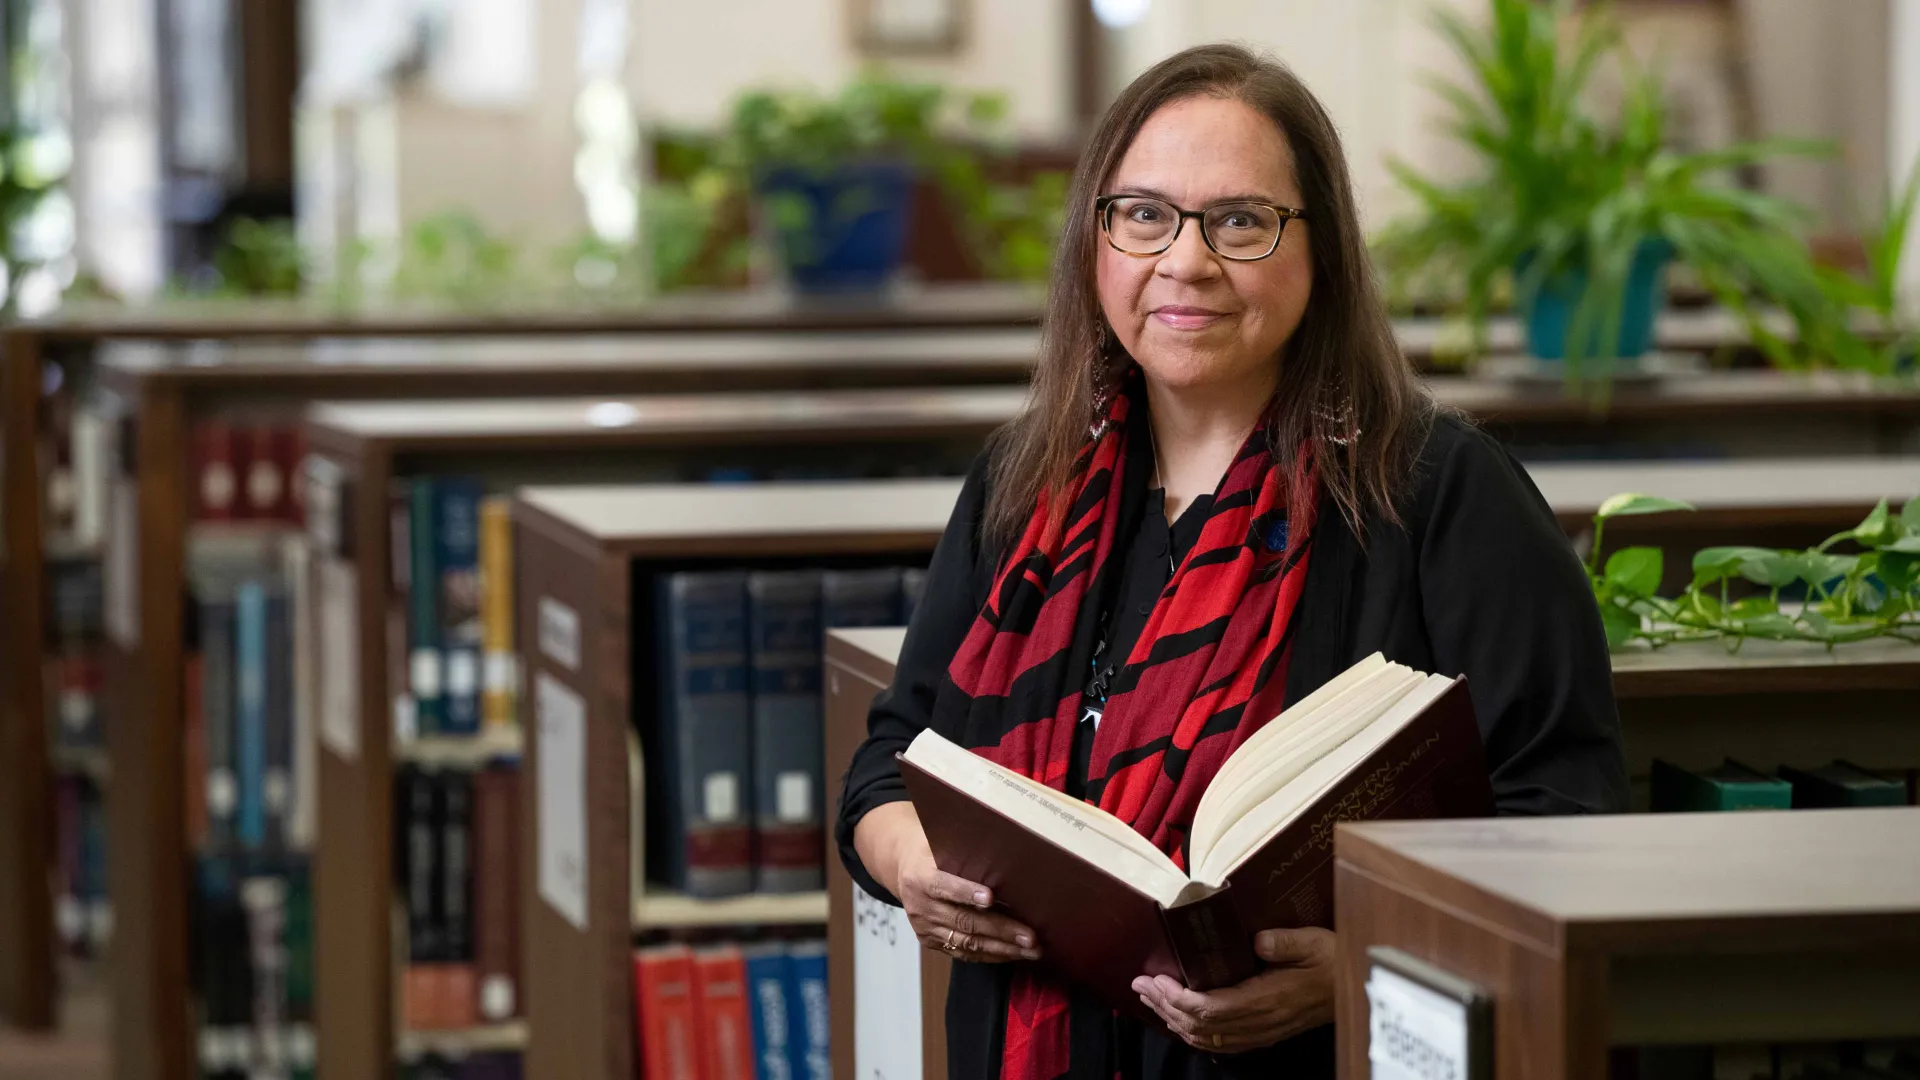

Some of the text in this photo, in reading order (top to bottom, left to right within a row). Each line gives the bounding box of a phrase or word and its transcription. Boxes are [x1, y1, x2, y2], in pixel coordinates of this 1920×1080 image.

[1268, 731, 1440, 884] AMERICAN WOMEN
[1310, 760, 1392, 834] MODERN
[1318, 782, 1396, 851] WTERS
